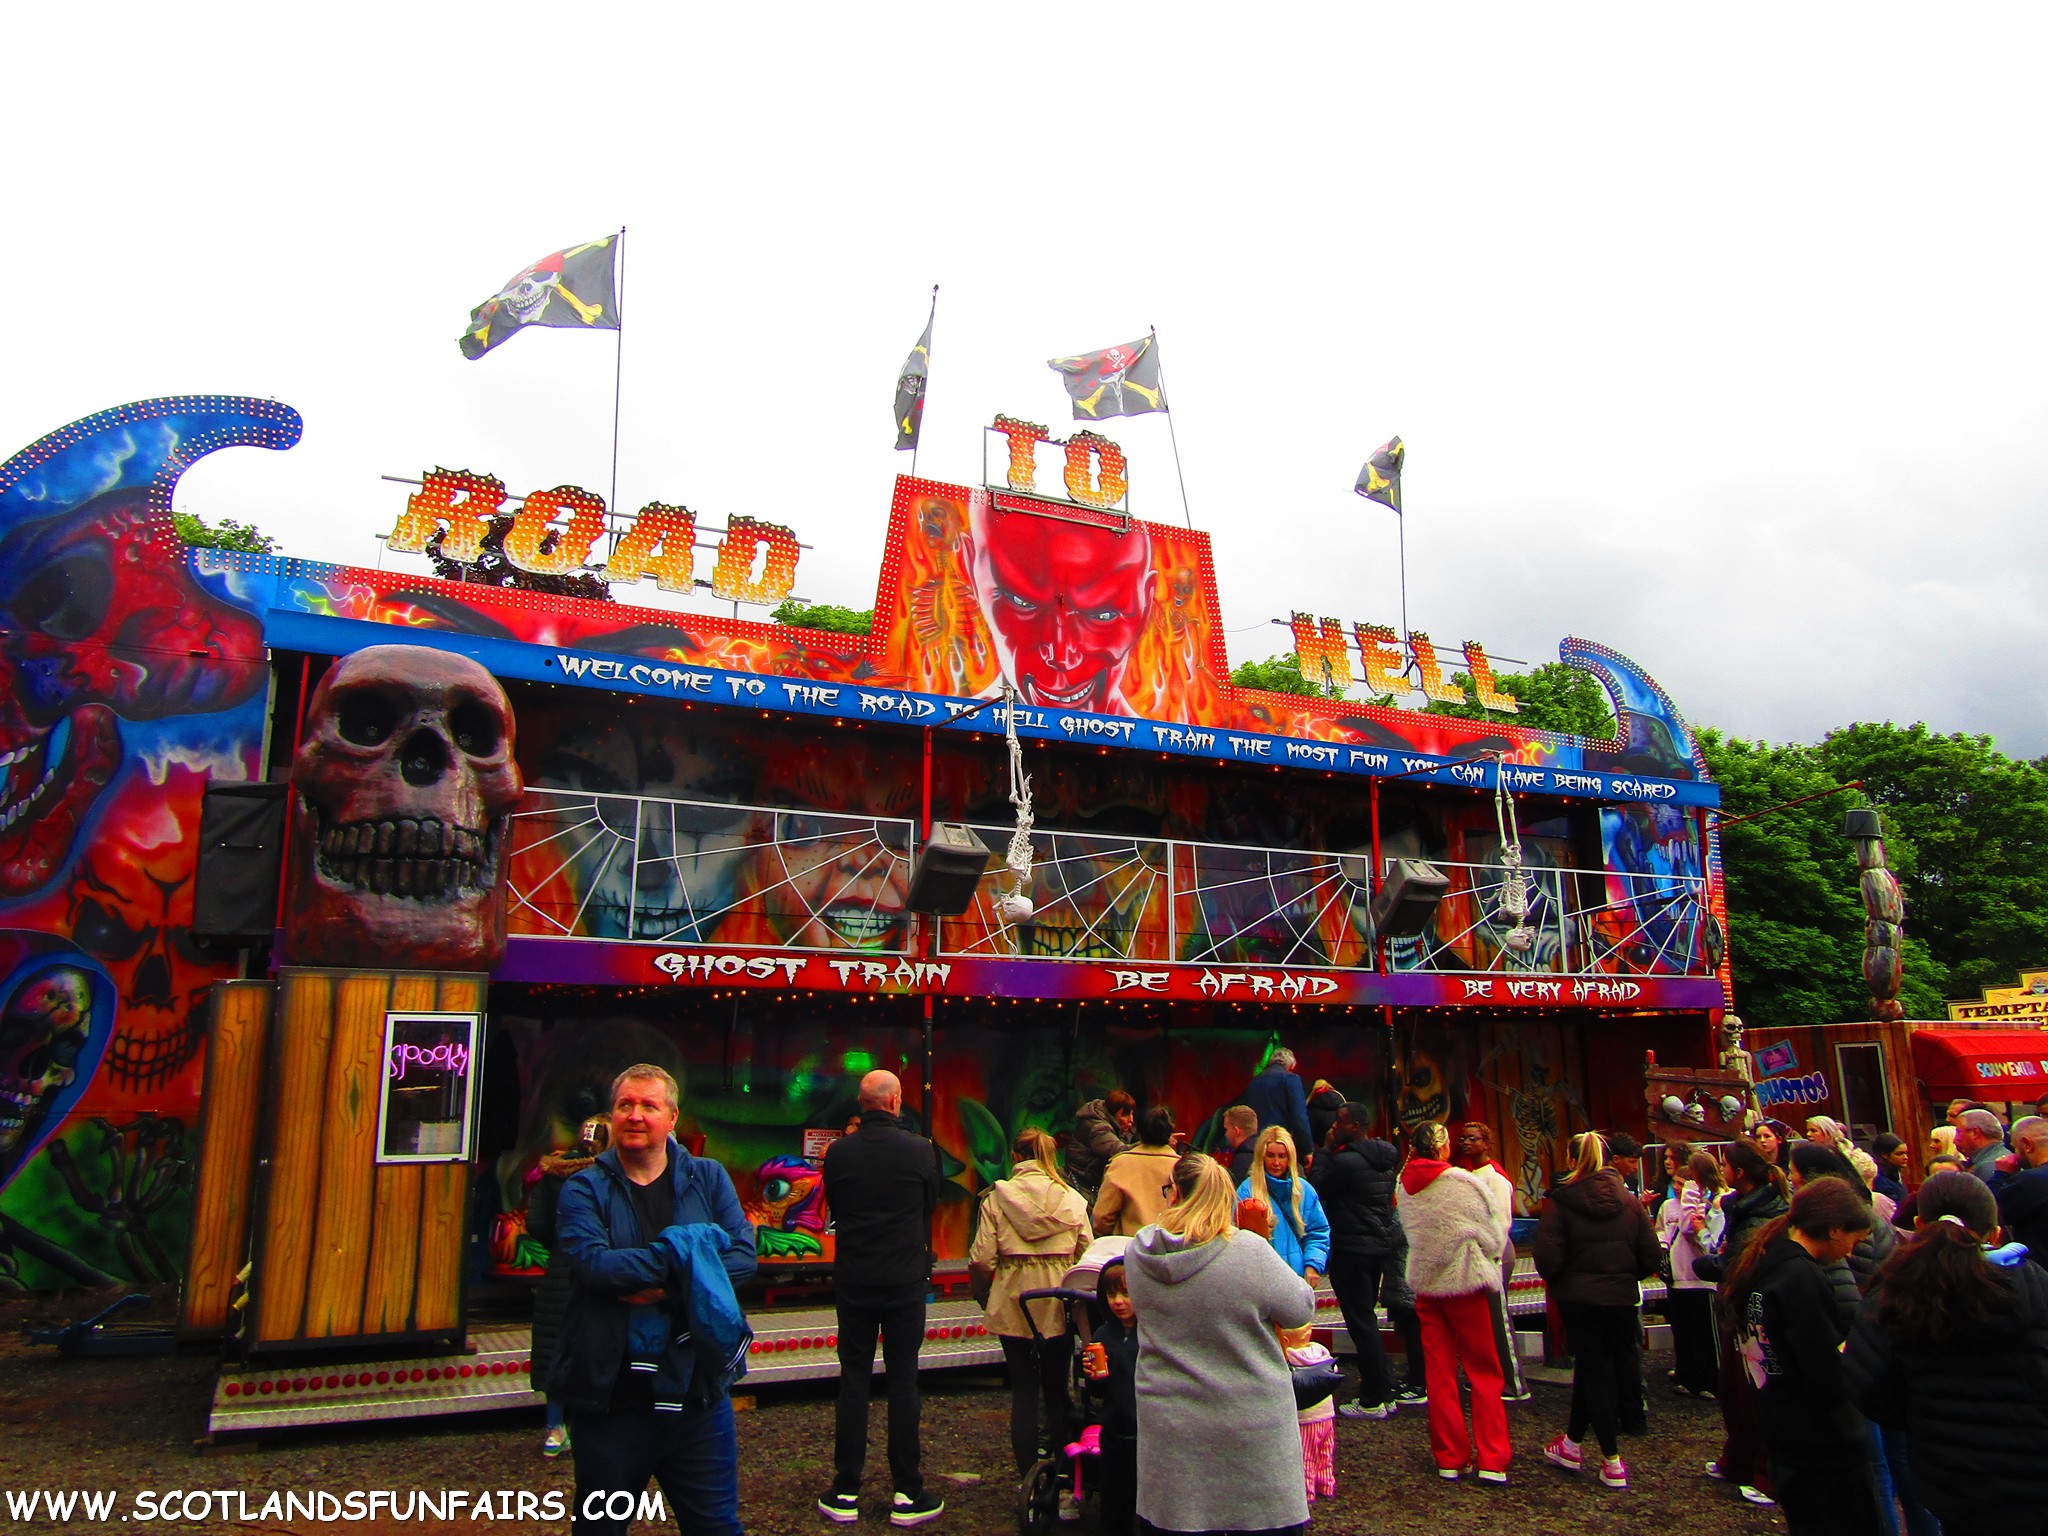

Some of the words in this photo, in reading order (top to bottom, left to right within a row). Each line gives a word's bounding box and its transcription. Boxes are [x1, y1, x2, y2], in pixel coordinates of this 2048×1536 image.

[387, 464, 800, 605] ROAD
[994, 413, 1128, 509] TO
[1291, 610, 1519, 713] HELL
[557, 654, 713, 693] WELCOME
[725, 677, 767, 699] TO
[782, 684, 840, 708] THE
[857, 691, 936, 719] ROAD
[945, 701, 981, 725] TO
[993, 708, 1049, 729] HELL
[1060, 716, 1137, 741] GHOST
[1152, 726, 1215, 752] TRAIN
[1228, 736, 1272, 757] THE
[1286, 743, 1339, 764] MOST
[1349, 751, 1390, 771] FUN
[1401, 758, 1440, 775] YOU
[1450, 763, 1484, 784] CAN
[1500, 766, 1548, 788] HAVE
[1554, 773, 1602, 794] BEING
[1611, 779, 1677, 799] SCARED
[654, 953, 807, 984] GHOST
[829, 956, 951, 989] TRAIN
[1105, 969, 1170, 993] BE
[1192, 968, 1339, 1000] AFRAID
[1460, 979, 1493, 999] BE
[1506, 979, 1562, 1001] VERY
[1570, 977, 1641, 1003] AFRAID
[1976, 1061, 2038, 1078] SOUVENIR
[1754, 1071, 1829, 1107] PHOTOS
